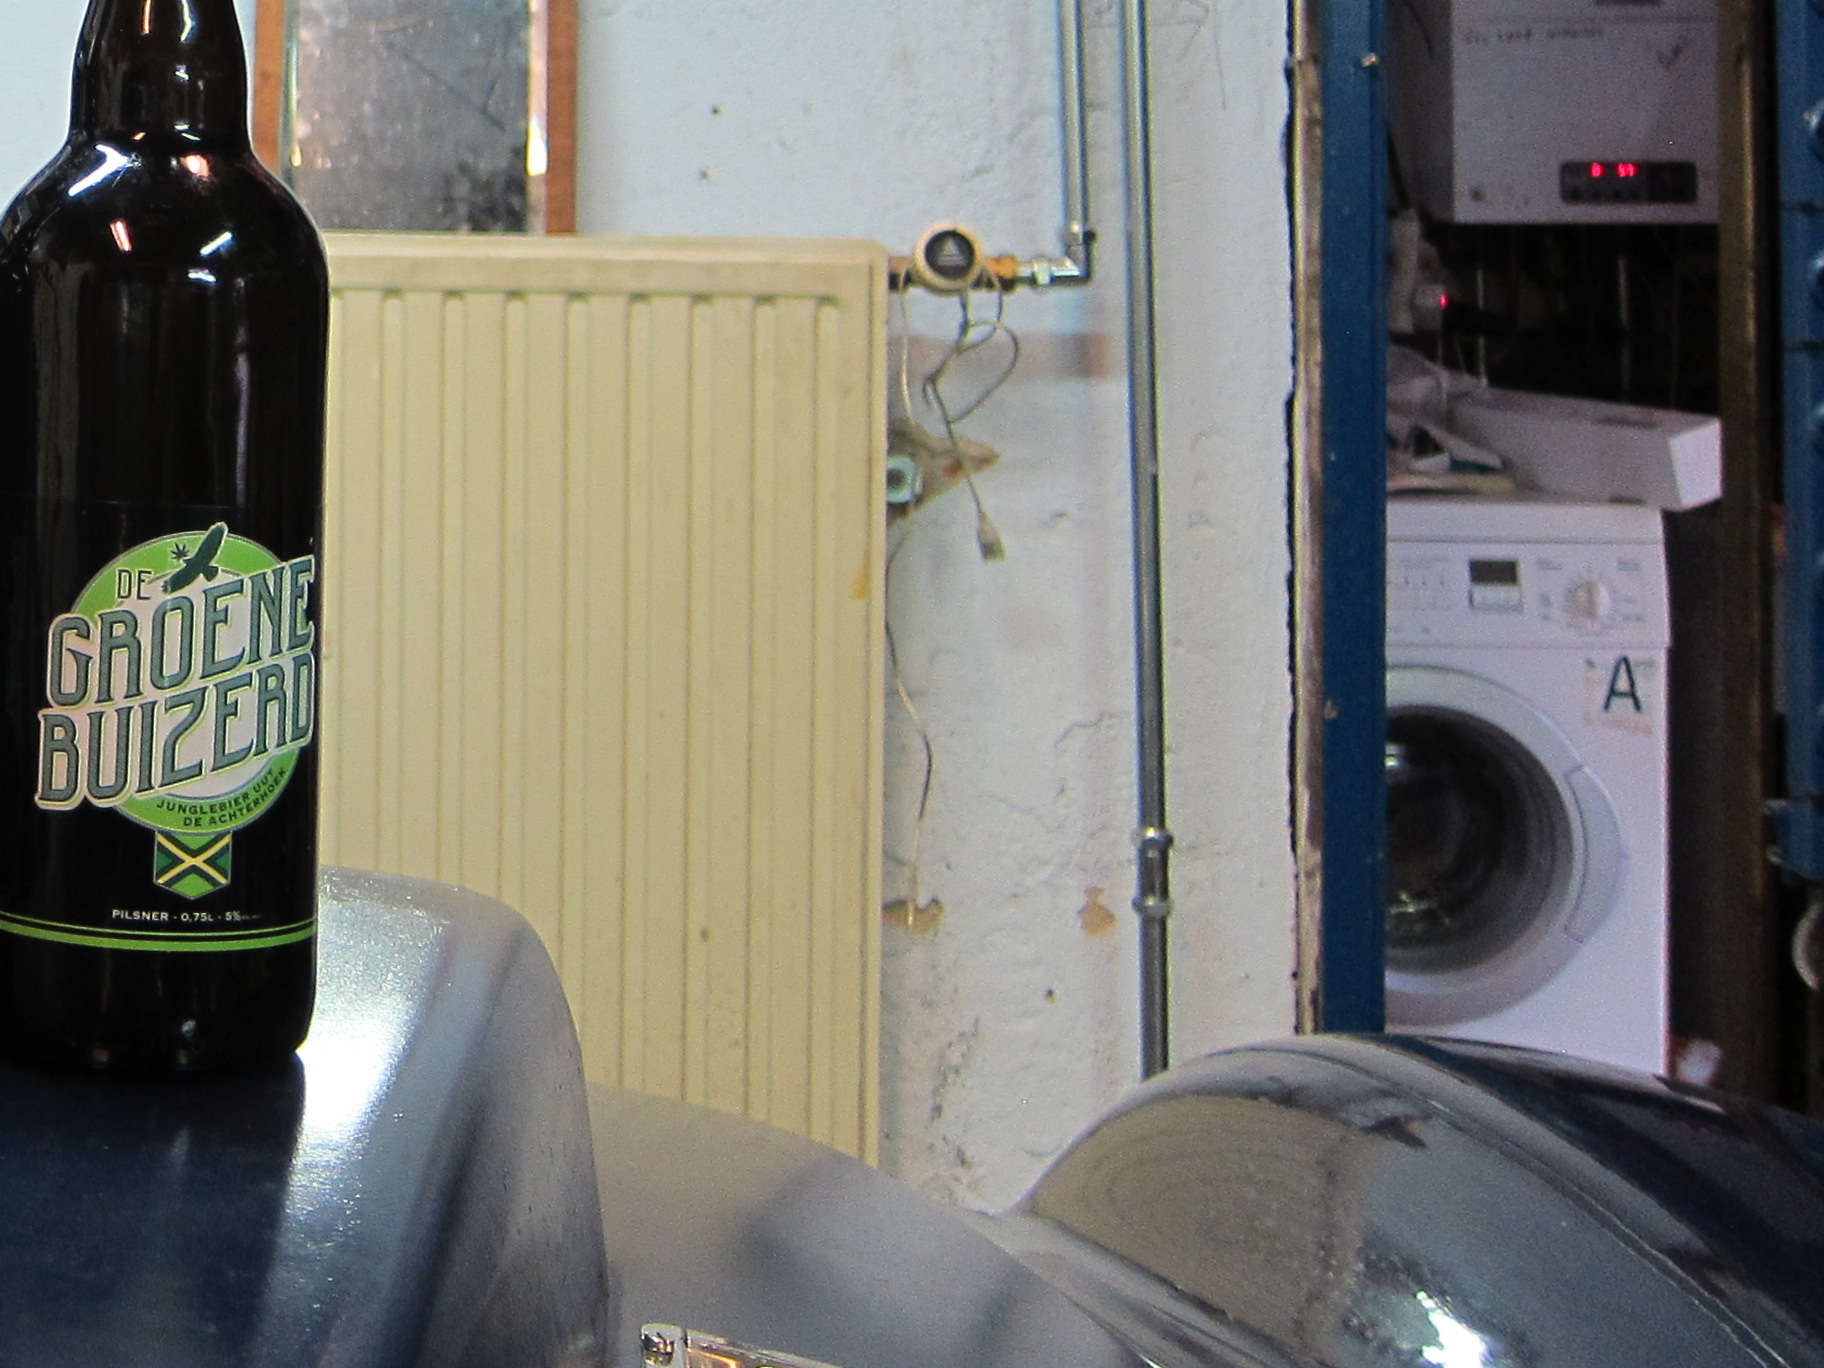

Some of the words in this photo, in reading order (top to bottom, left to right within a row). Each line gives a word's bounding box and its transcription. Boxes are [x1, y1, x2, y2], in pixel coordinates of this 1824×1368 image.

[116, 569, 152, 600] DE
[50, 558, 314, 708] GROENE
[1603, 654, 1643, 714] A
[39, 653, 314, 804] BUIZERD
[157, 792, 250, 815] JUNGLEBIER
[253, 768, 274, 793] UUT
[183, 817, 202, 827] DE
[208, 767, 287, 826] ACHTERHOEK
[112, 909, 169, 921] PILSNER
